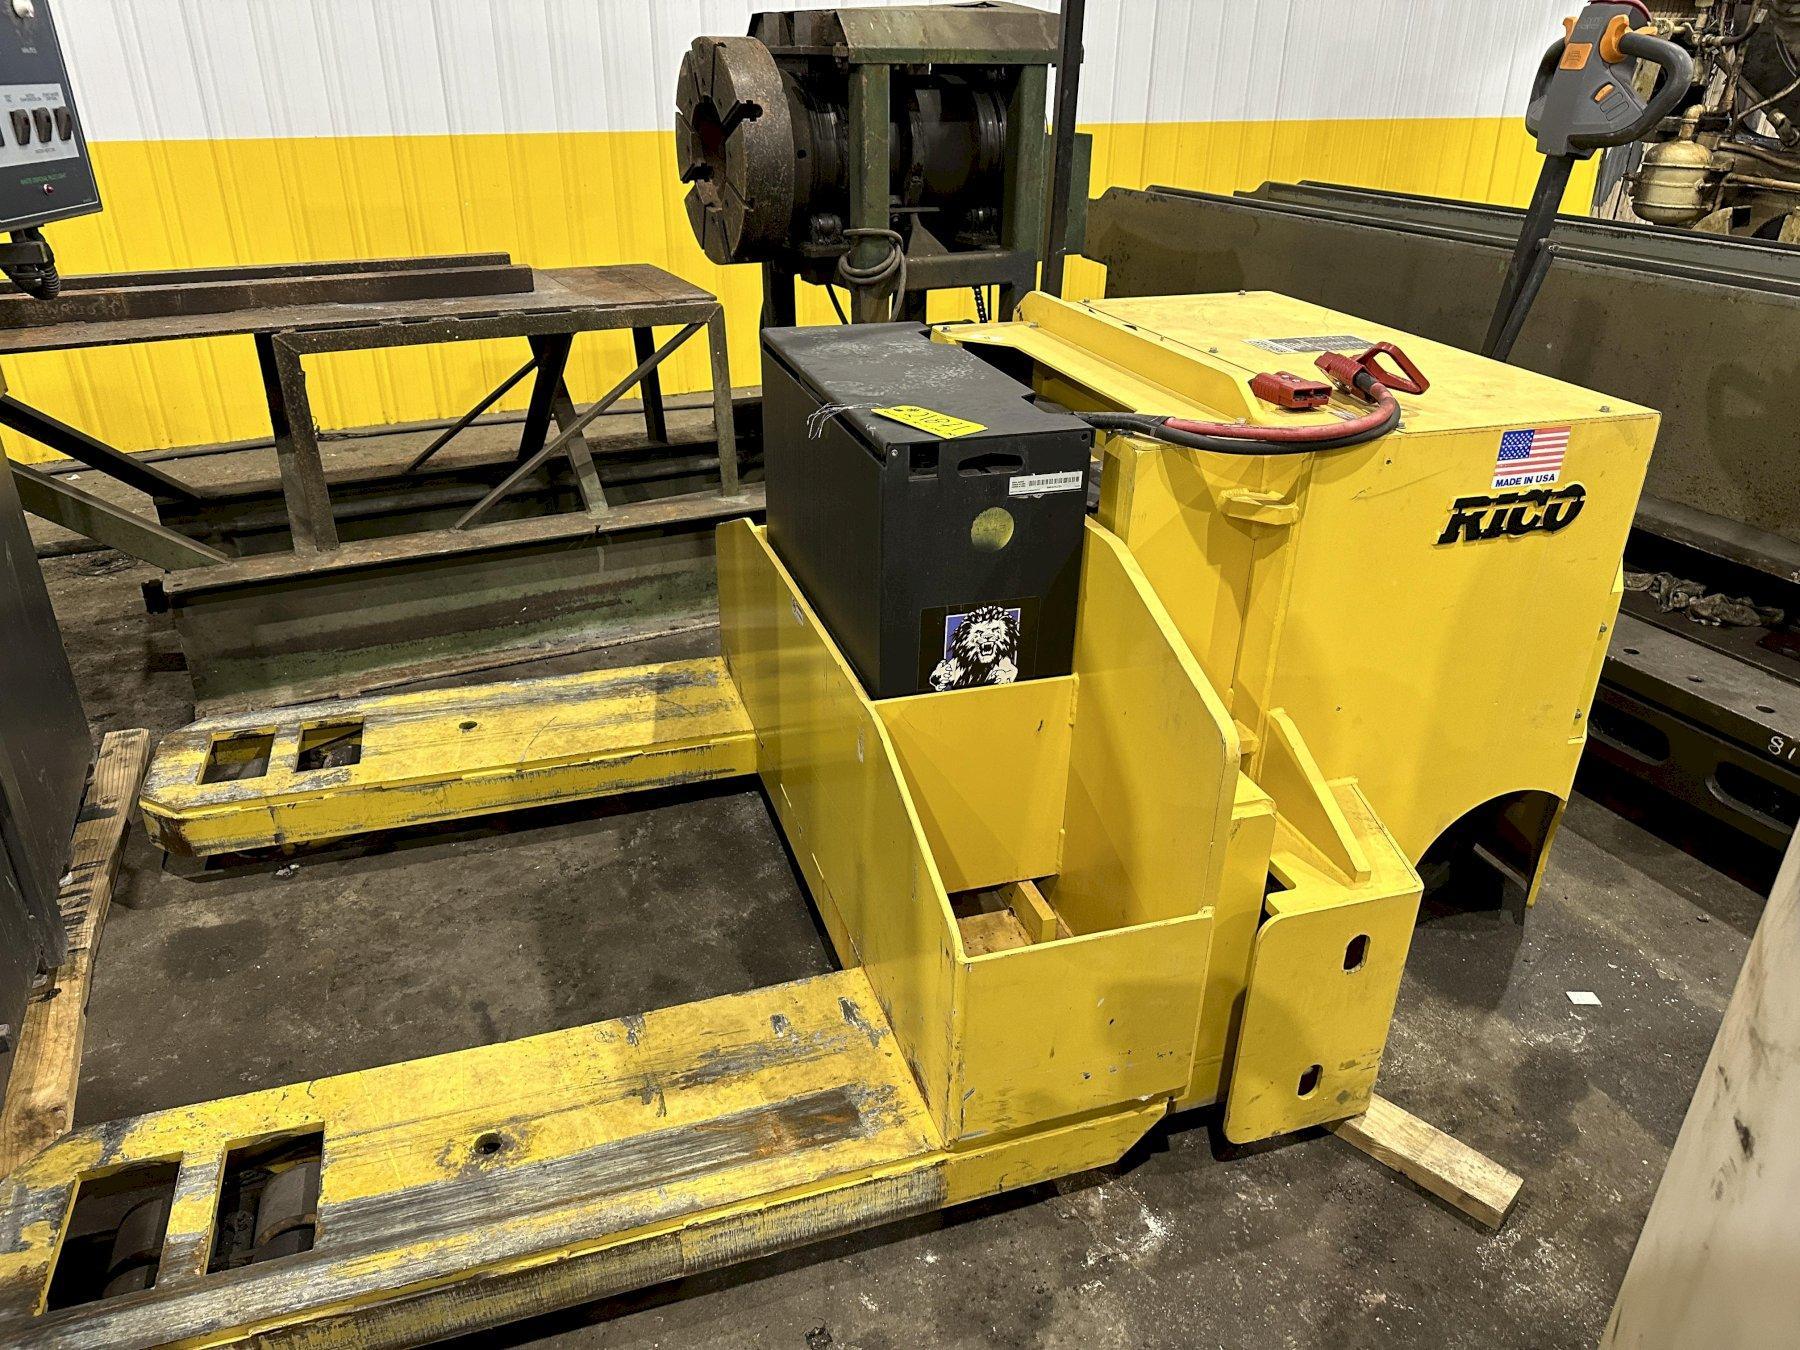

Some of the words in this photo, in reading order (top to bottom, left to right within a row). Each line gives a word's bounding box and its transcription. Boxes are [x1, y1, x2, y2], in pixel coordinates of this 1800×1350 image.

[1495, 477, 1521, 487] MADE
[1524, 476, 1533, 484] IN
[1536, 473, 1555, 482] USA
[1436, 483, 1586, 545] RICO
